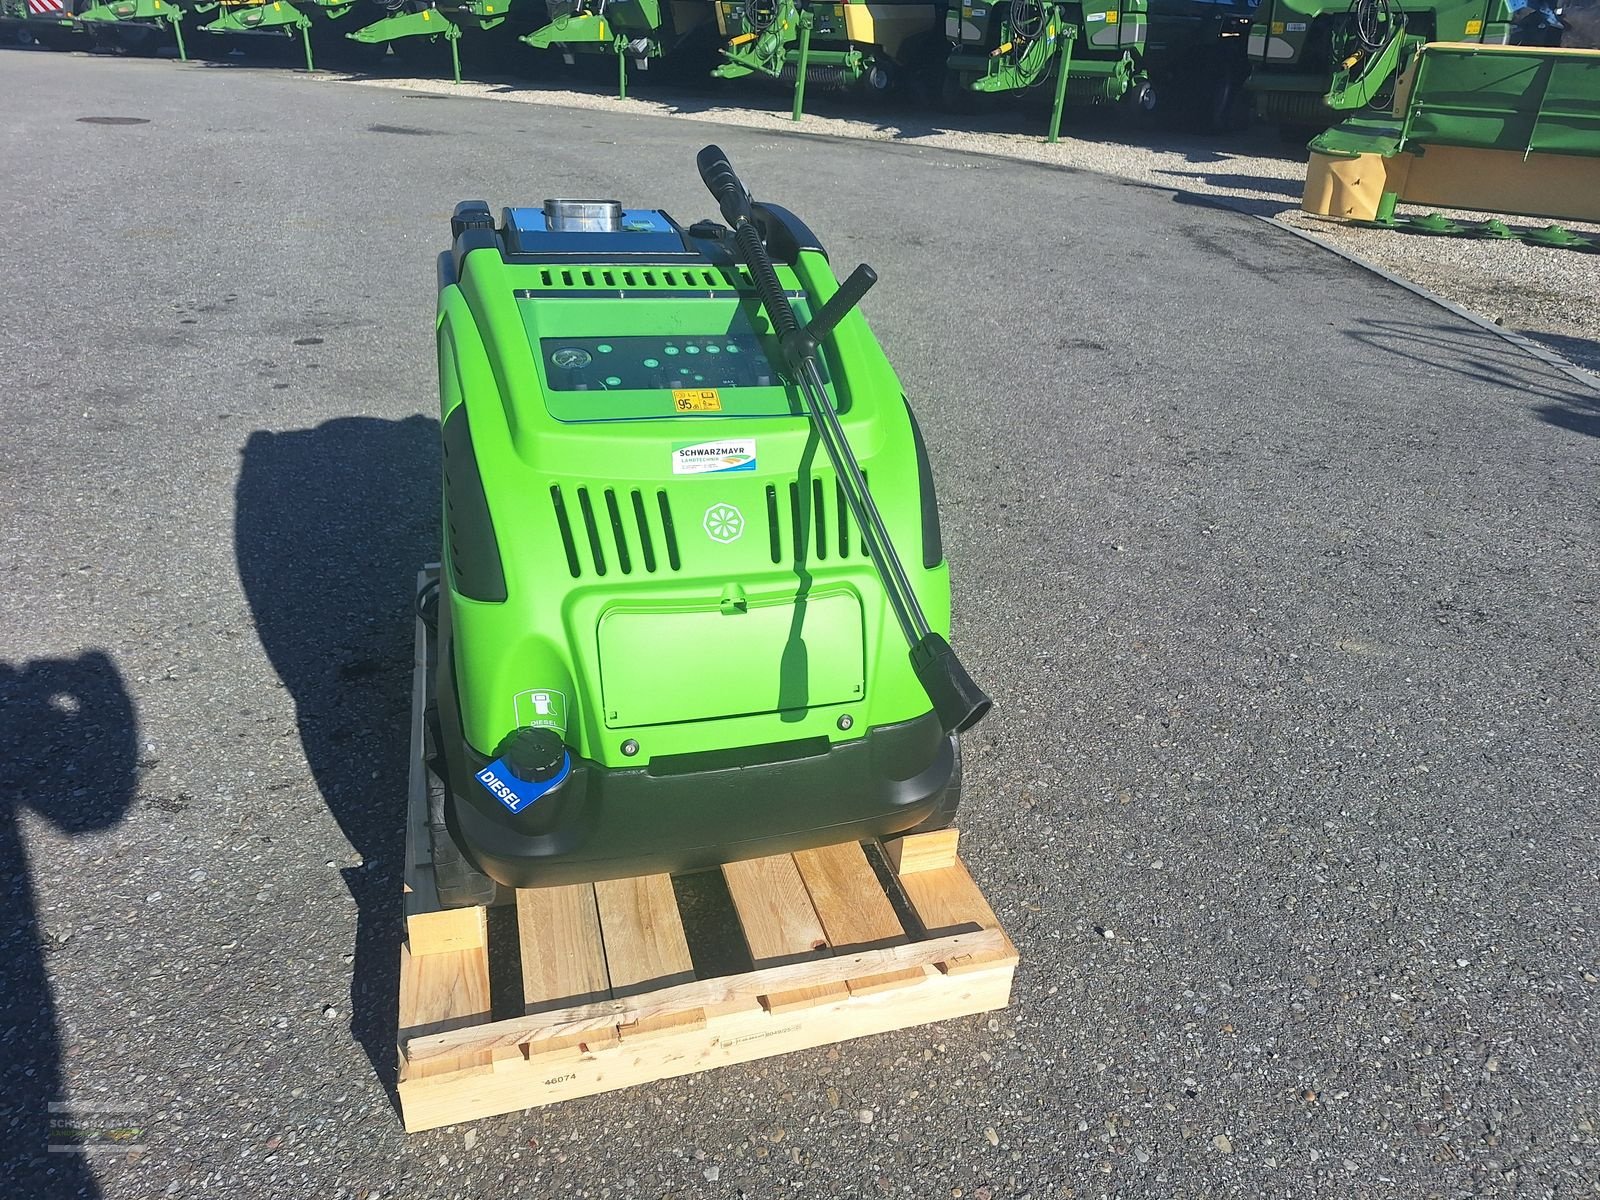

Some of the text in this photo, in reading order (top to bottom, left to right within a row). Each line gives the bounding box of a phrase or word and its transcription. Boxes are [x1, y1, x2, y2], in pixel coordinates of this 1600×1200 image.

[678, 399, 692, 409] 95
[680, 447, 745, 457] SCHWARZMAYR
[480, 771, 521, 810] DIESEL
[544, 1073, 576, 1085] 46074
